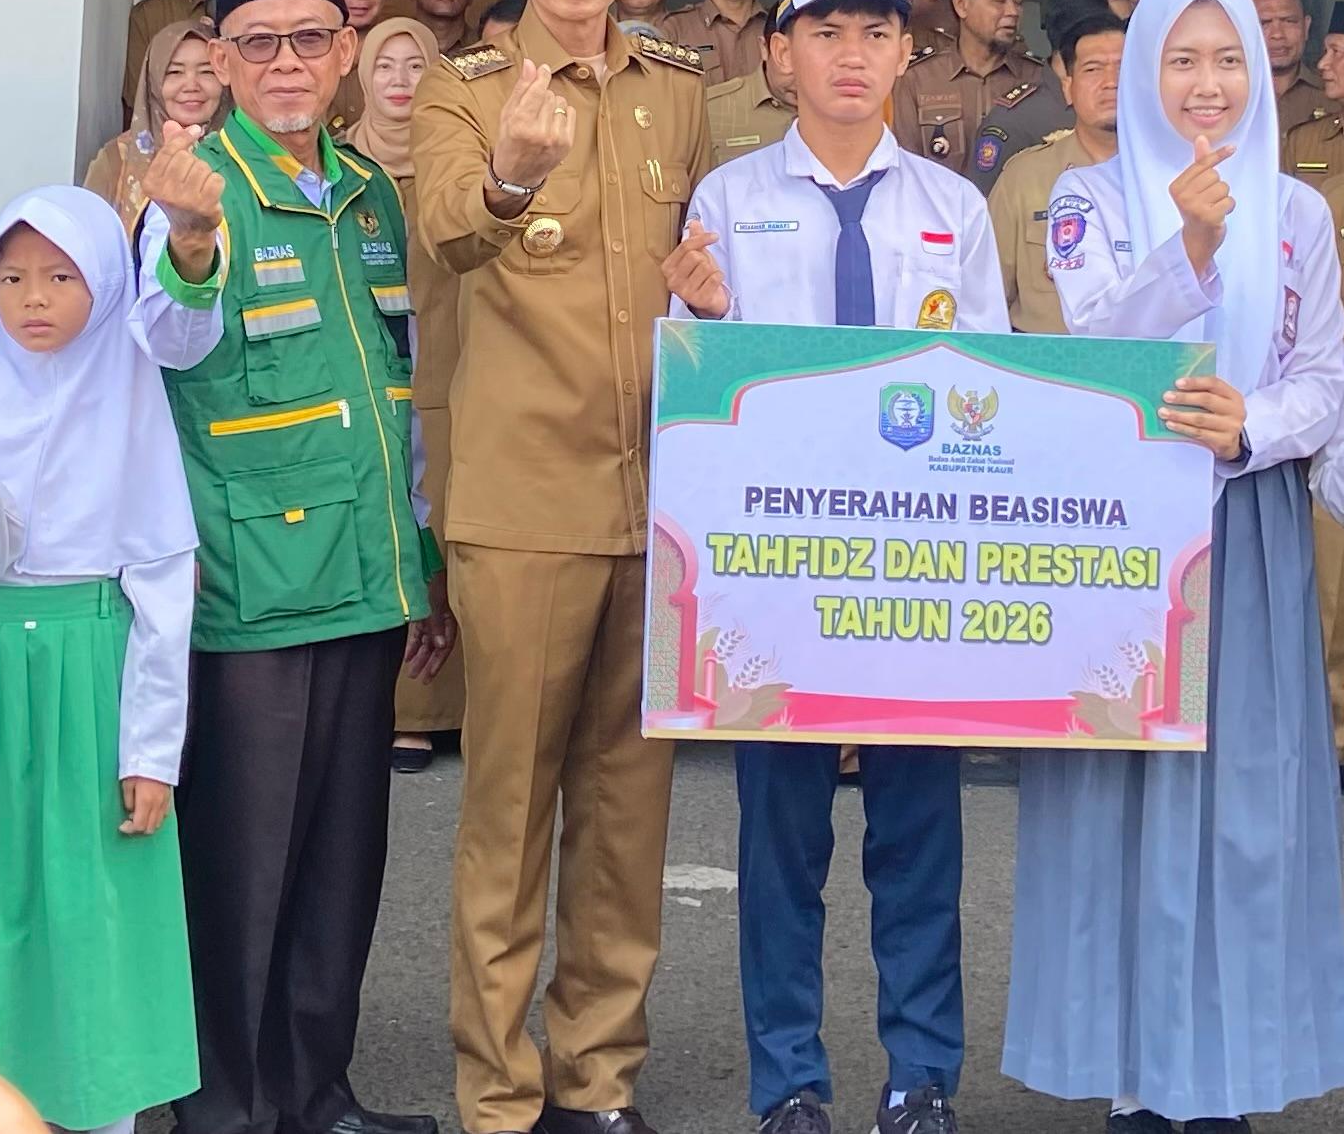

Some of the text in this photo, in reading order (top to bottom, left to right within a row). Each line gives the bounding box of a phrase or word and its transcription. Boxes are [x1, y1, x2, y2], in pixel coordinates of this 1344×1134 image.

[254, 244, 295, 262] BAZNAS
[941, 443, 1002, 456] BAZNAS
[929, 464, 1014, 474] KABUPATEN KAUR
[744, 487, 1128, 526] PENYERAHAN BEASISWA
[706, 533, 1160, 589] TAHFIDZ DAN PRESTASI
[815, 596, 1053, 644] TAHUN 2026
